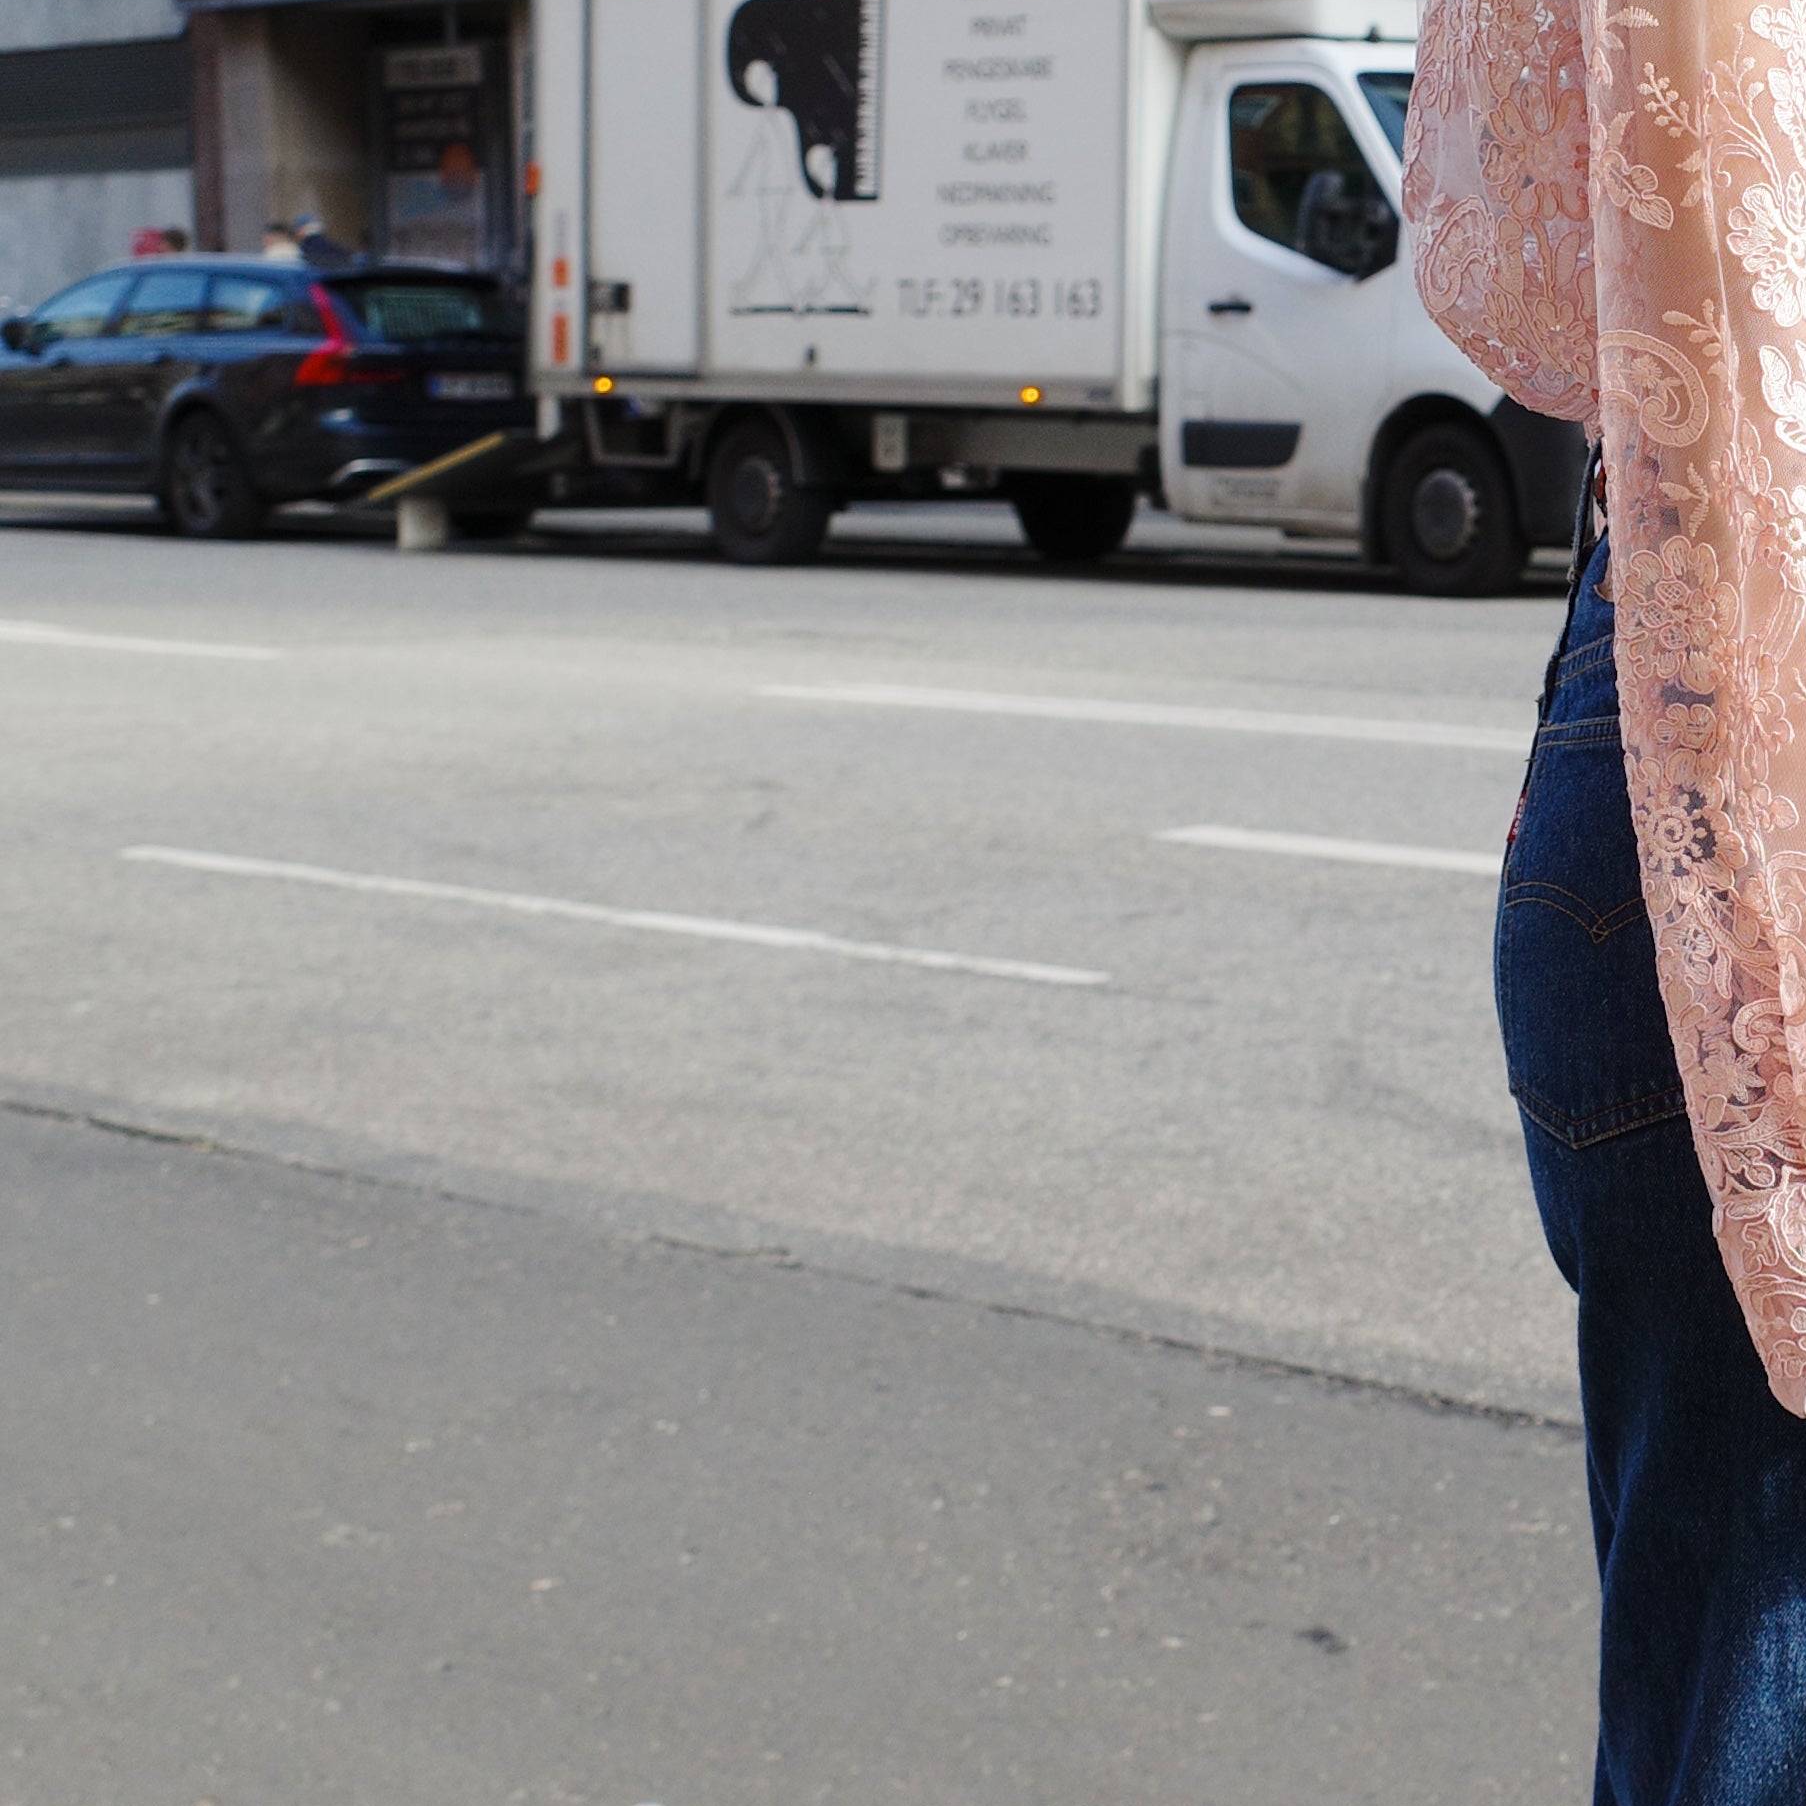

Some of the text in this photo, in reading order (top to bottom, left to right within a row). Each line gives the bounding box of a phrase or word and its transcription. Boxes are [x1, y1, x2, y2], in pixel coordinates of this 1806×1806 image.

[952, 277, 985, 319] 29
[994, 277, 1042, 320] 163
[1054, 277, 1102, 320] 163
